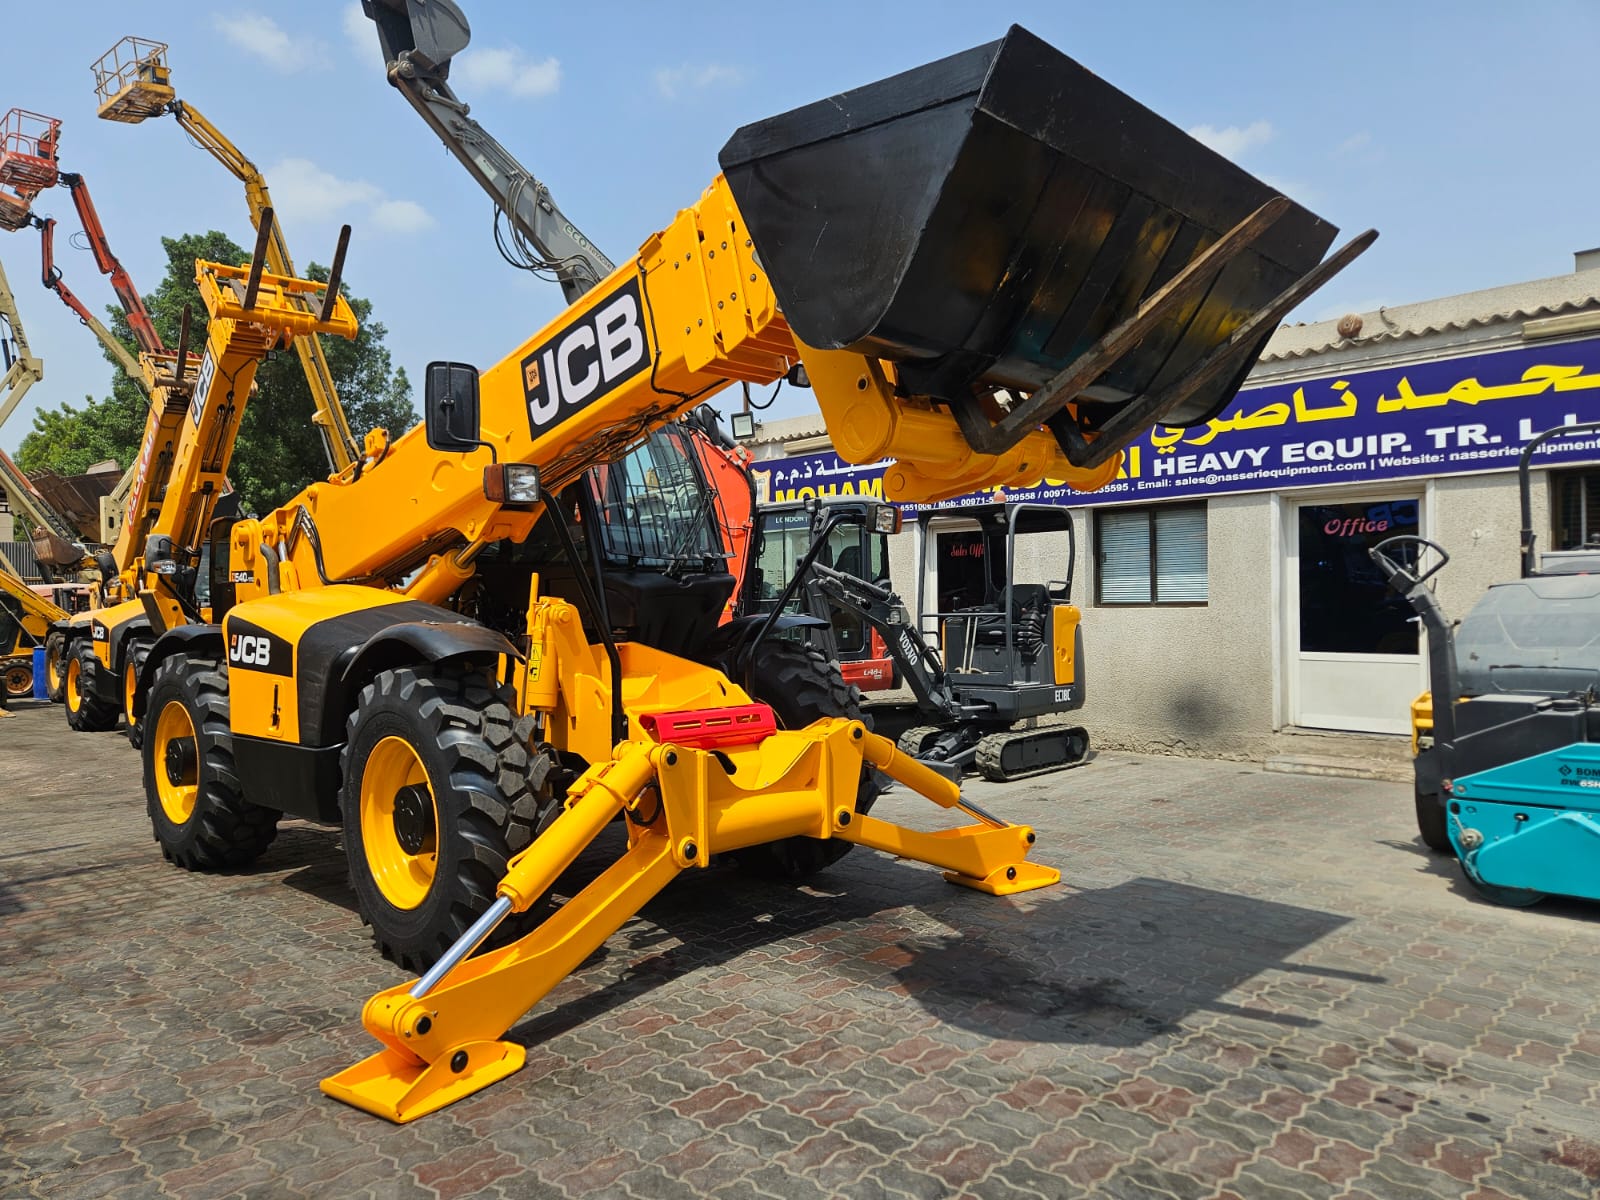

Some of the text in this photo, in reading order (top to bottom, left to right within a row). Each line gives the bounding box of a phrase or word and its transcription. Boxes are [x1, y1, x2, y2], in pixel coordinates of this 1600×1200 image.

[564, 223, 588, 249] eco
[529, 294, 644, 426] JCB
[193, 351, 215, 425] JCB
[1153, 446, 1270, 477] HEAVY
[1281, 432, 1412, 464] EQUIP.
[1425, 423, 1502, 449] TR.
[774, 477, 891, 503] MOHAM
[938, 500, 958, 509] Mob:
[960, 491, 1036, 506] 00971-5599558
[1137, 479, 1172, 490] Email:
[1175, 460, 1367, 486] sales@nasseriequipment.com
[1378, 452, 1445, 468] Website:
[1323, 516, 1389, 537] Office
[230, 634, 271, 666] JCB
[899, 629, 918, 666] VOLVO
